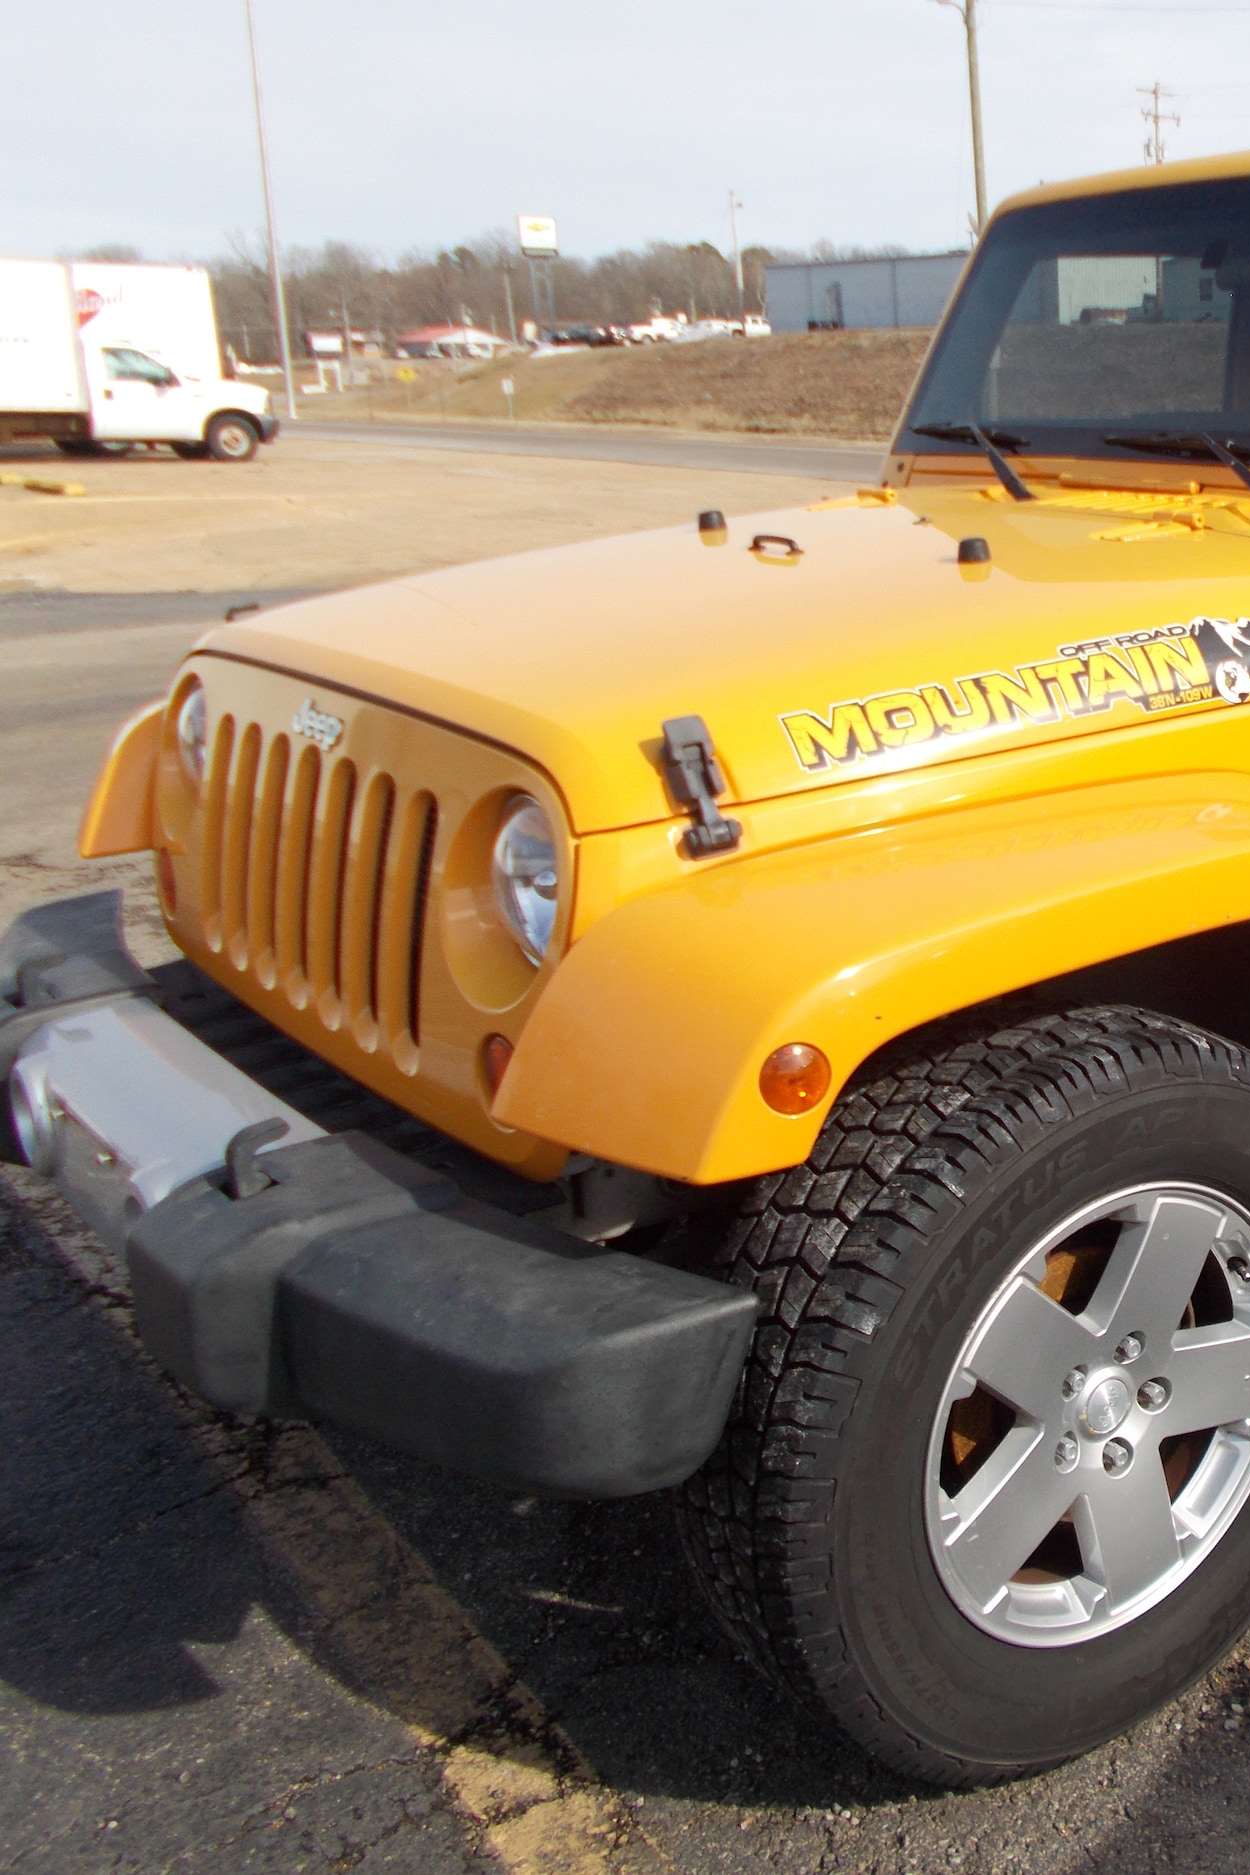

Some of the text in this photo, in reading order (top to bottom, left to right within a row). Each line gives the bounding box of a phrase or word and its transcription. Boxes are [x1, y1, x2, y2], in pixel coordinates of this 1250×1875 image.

[1060, 626, 1187, 657] OFF ROAD
[291, 698, 341, 751] Jeep
[780, 636, 1211, 771] MOUNTAIN
[895, 1139, 1088, 1389] STRATUS
